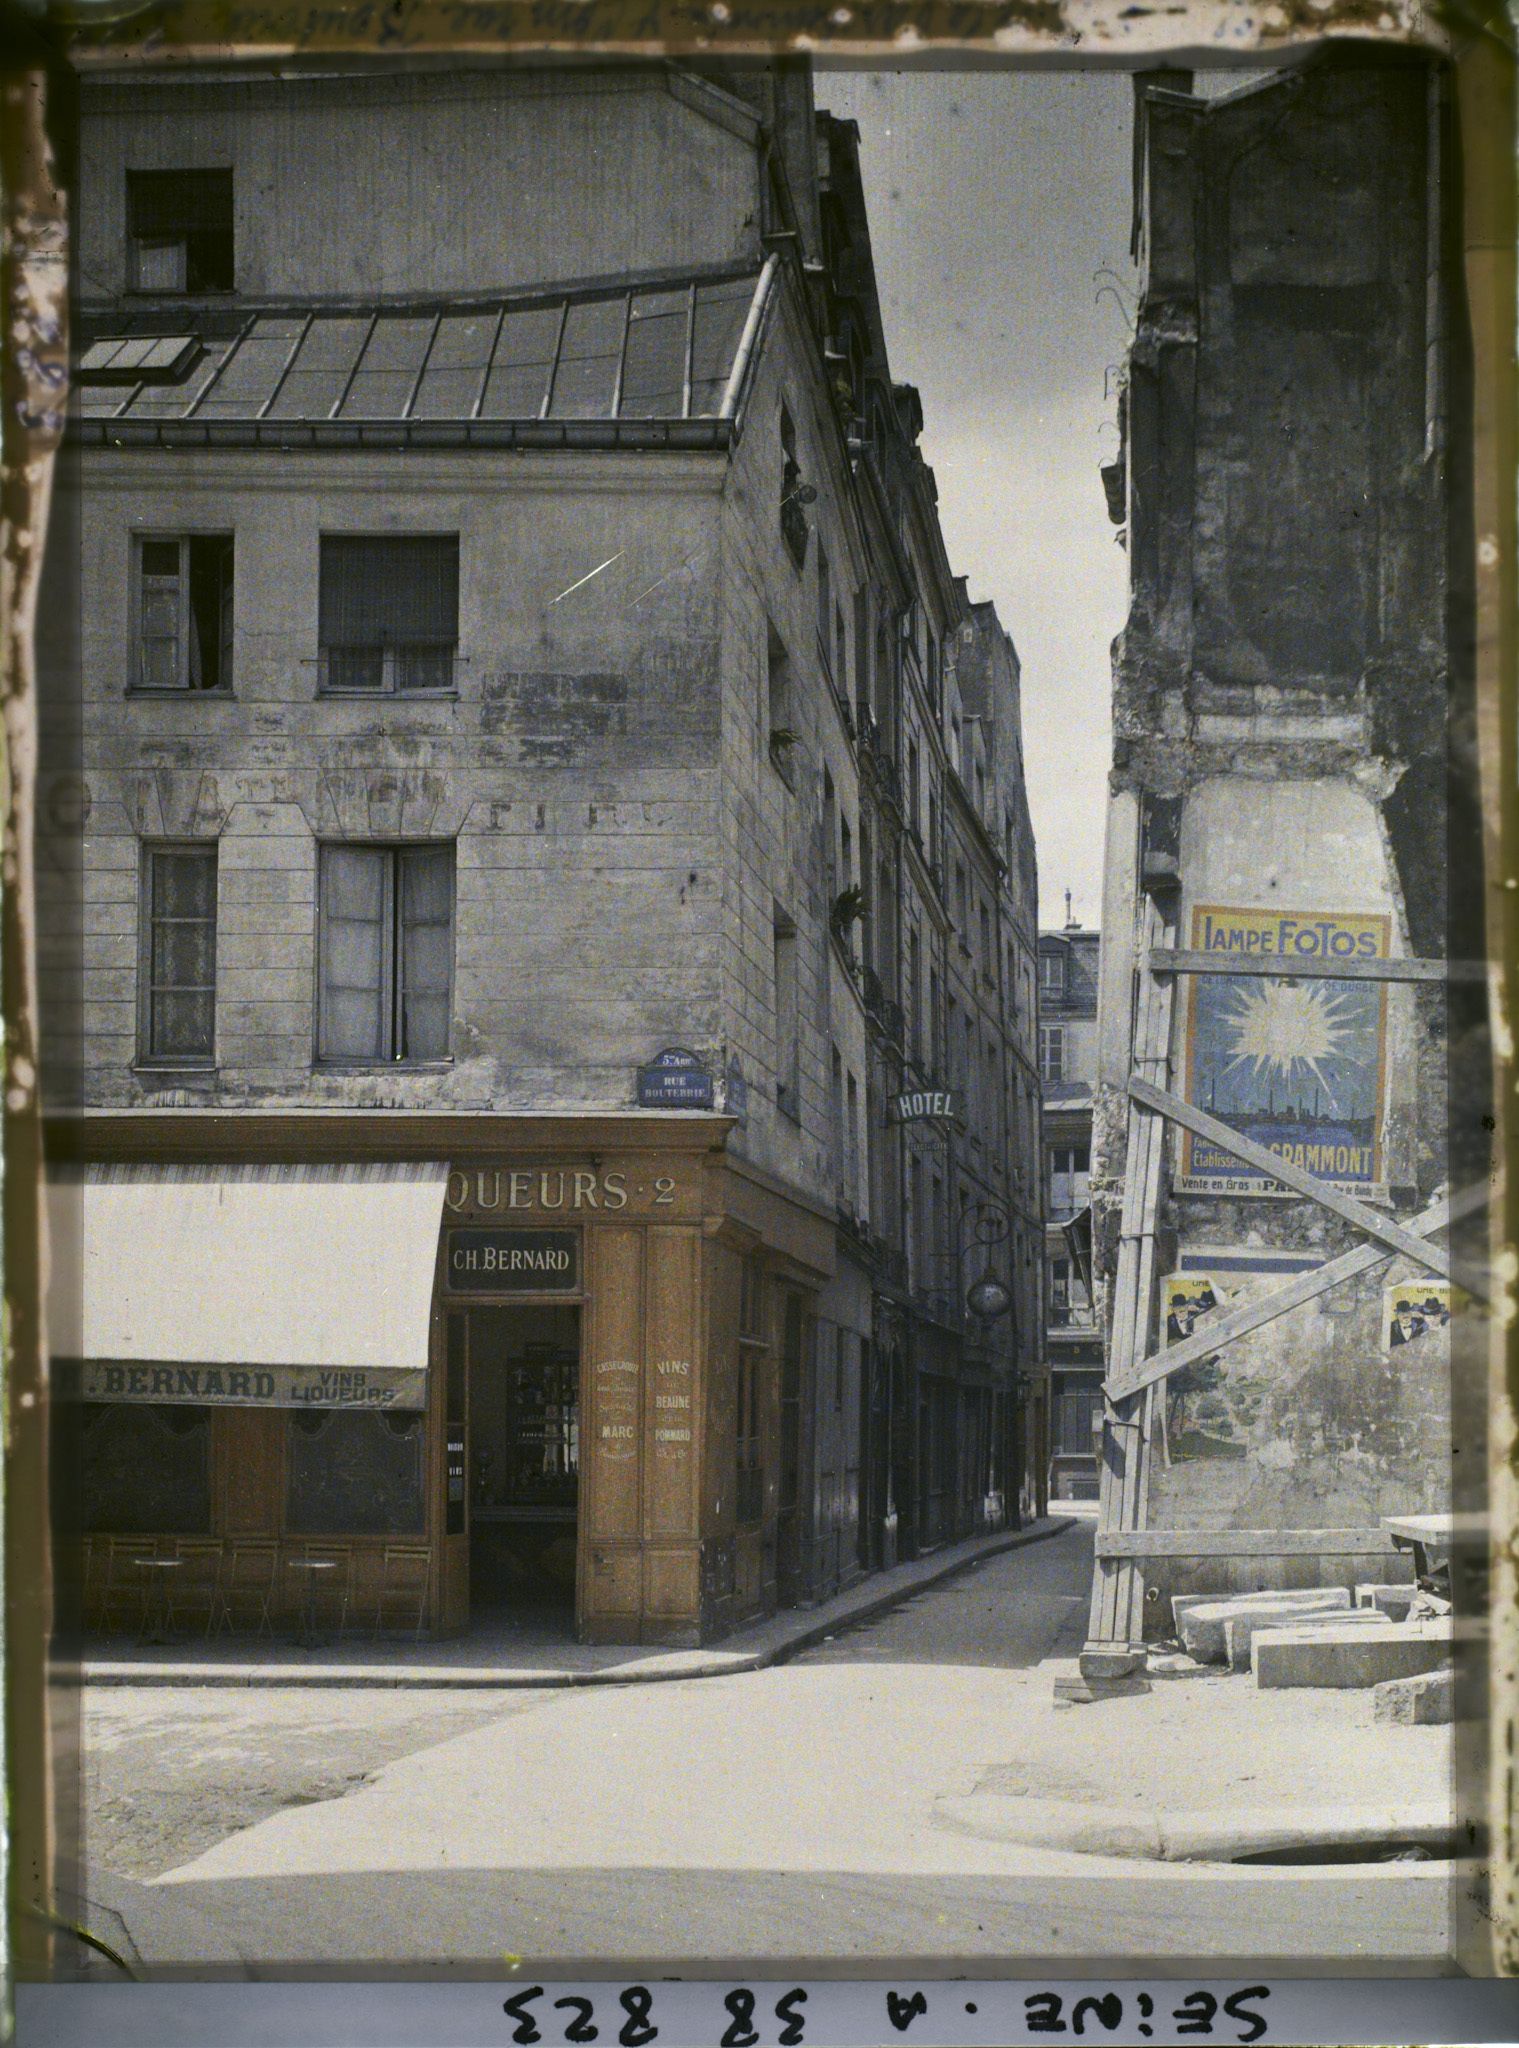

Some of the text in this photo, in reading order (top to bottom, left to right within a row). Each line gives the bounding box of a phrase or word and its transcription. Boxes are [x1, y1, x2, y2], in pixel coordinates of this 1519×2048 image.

[664, 1076, 687, 1086] RUE
[899, 1092, 954, 1118] HOTEL
[655, 1177, 676, 1203] 2
[1182, 1177, 1208, 1190] Vente
[1212, 1180, 1223, 1189] en
[1226, 1179, 1249, 1190] Gros
[483, 1247, 569, 1270] BERNARD
[657, 1360, 690, 1375] VINS
[105, 1367, 275, 1399] BERNARD
[320, 1371, 366, 1387] VINS
[656, 1395, 691, 1409] BEAUNE
[602, 1425, 634, 1438] MARC
[655, 1429, 691, 1441] POMMARD
[503, 1987, 657, 2046] 823
[723, 1988, 808, 2047] 38
